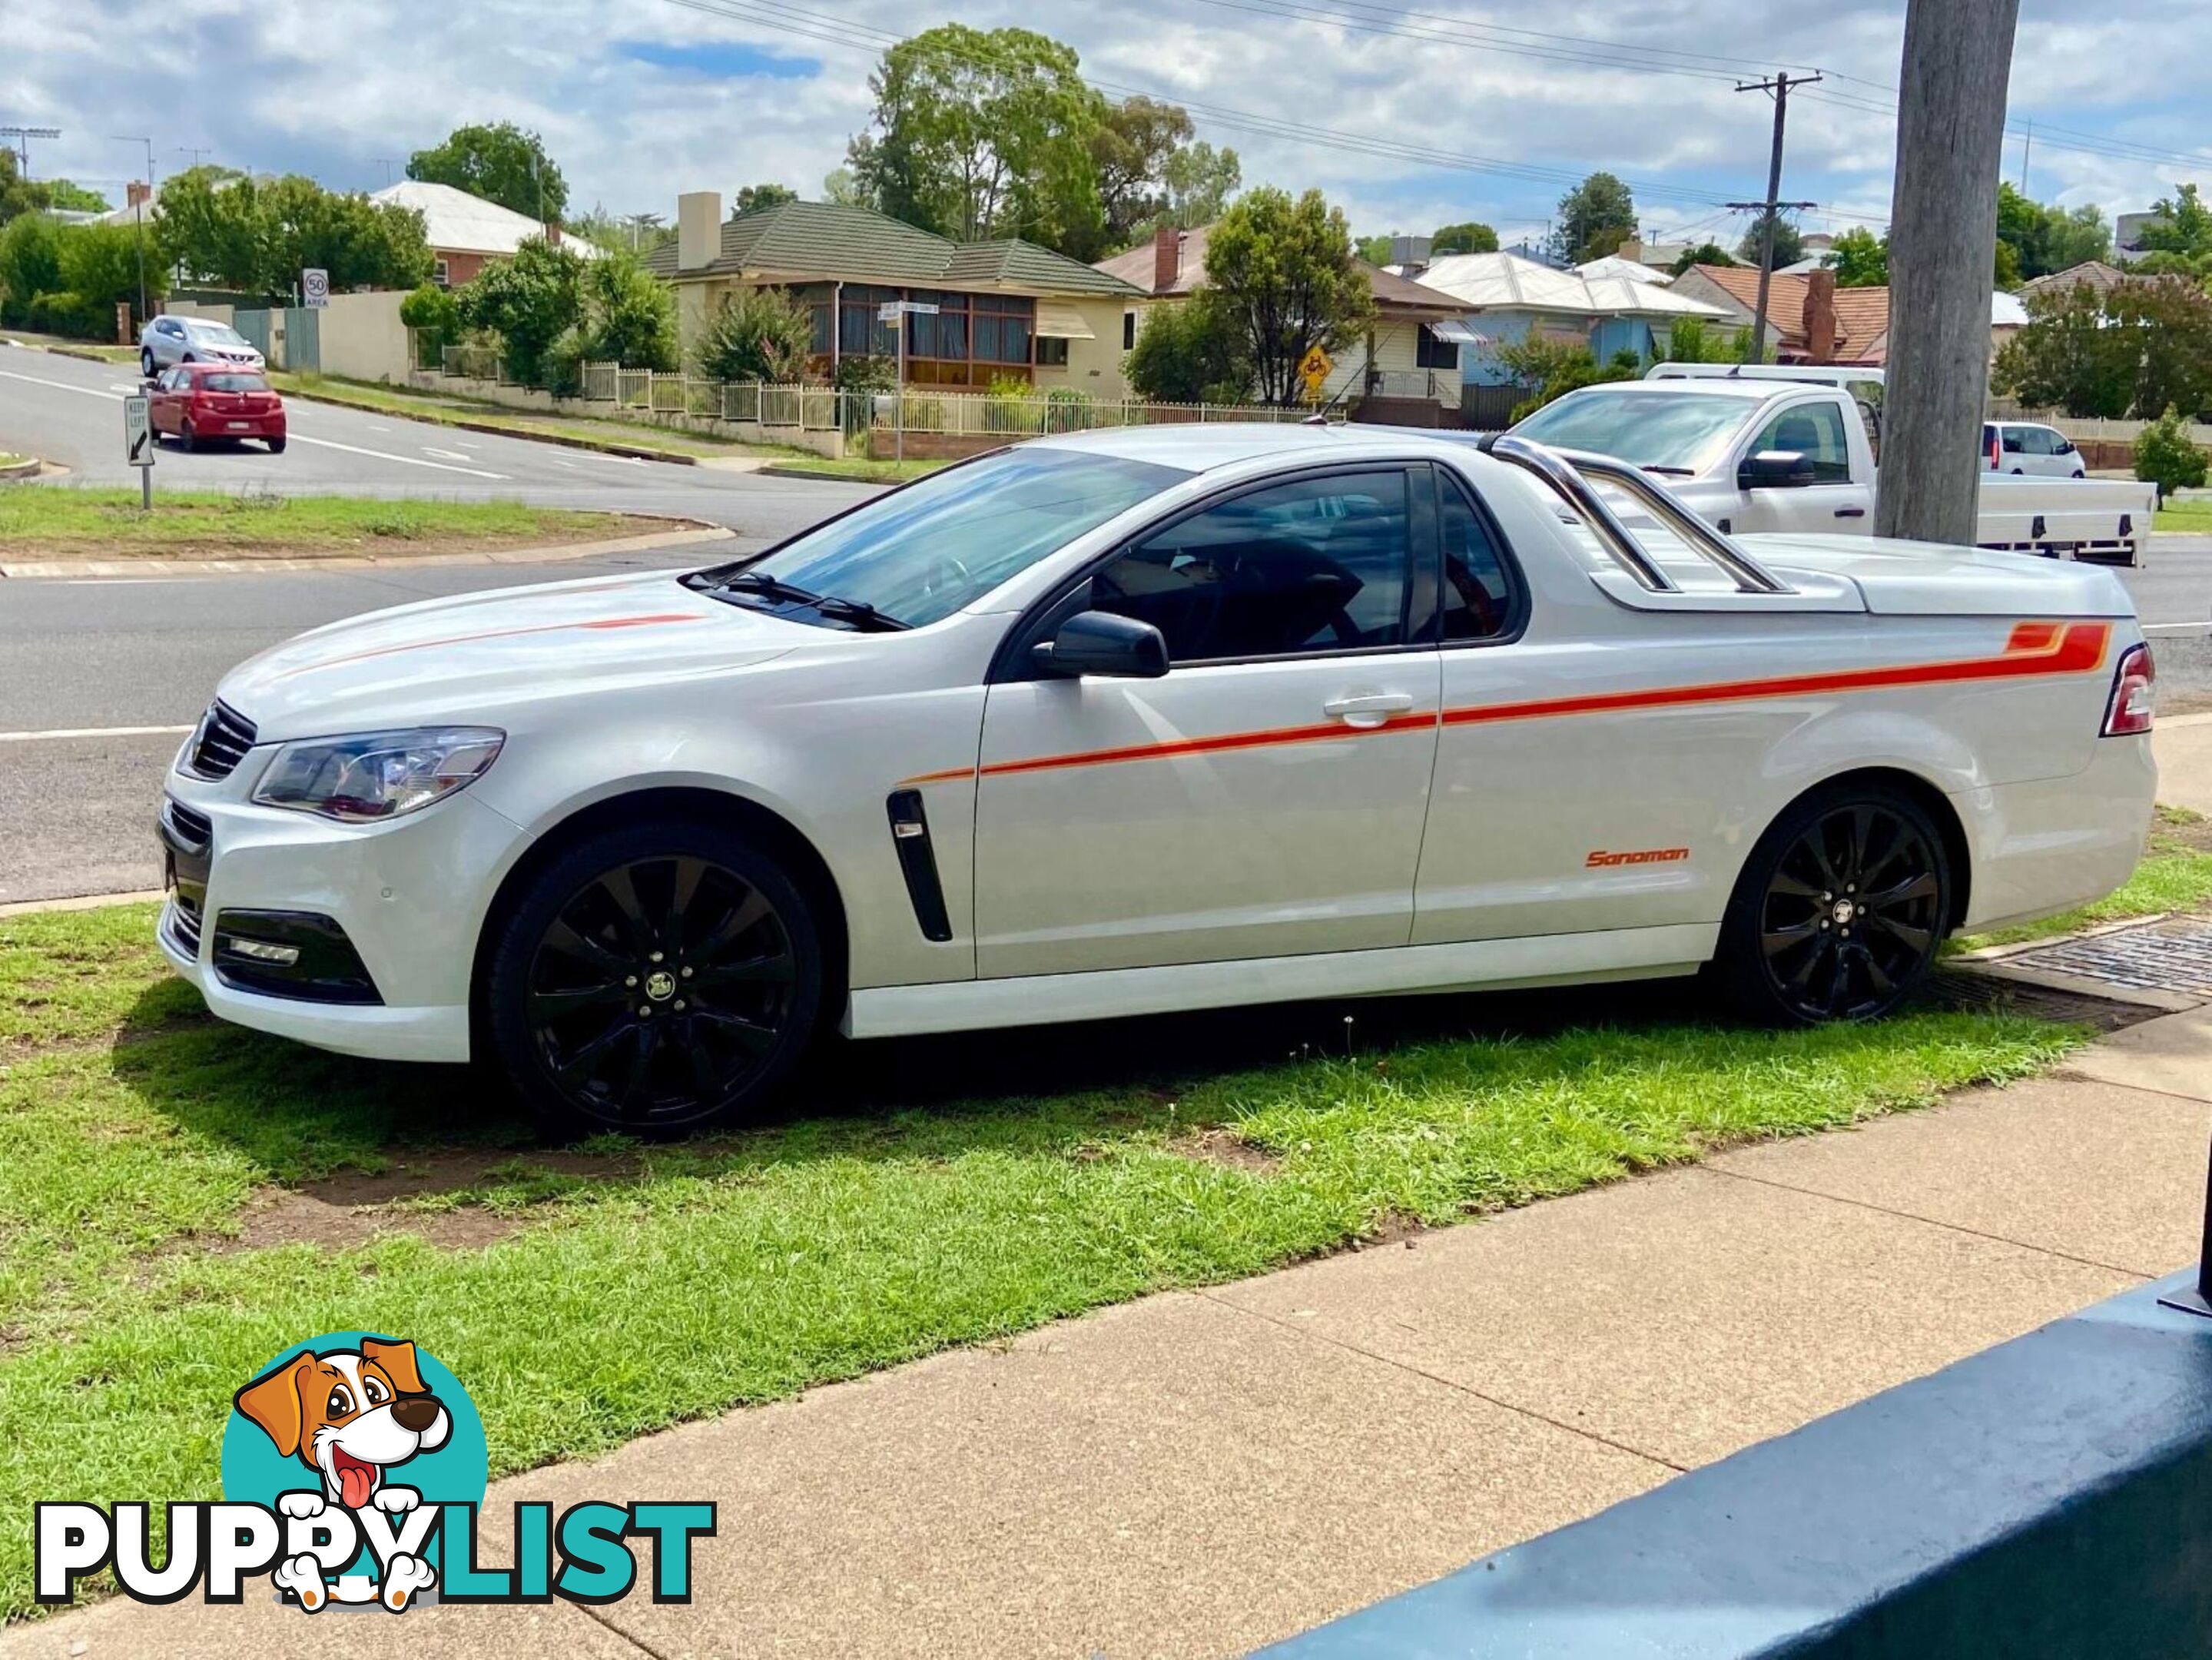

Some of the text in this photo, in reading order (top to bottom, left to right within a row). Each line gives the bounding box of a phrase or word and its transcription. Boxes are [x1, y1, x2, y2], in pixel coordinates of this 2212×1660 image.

[309, 279, 324, 290] 50
[307, 298, 329, 307] AREA
[129, 402, 145, 413] KEEP
[131, 416, 144, 427] LEFT
